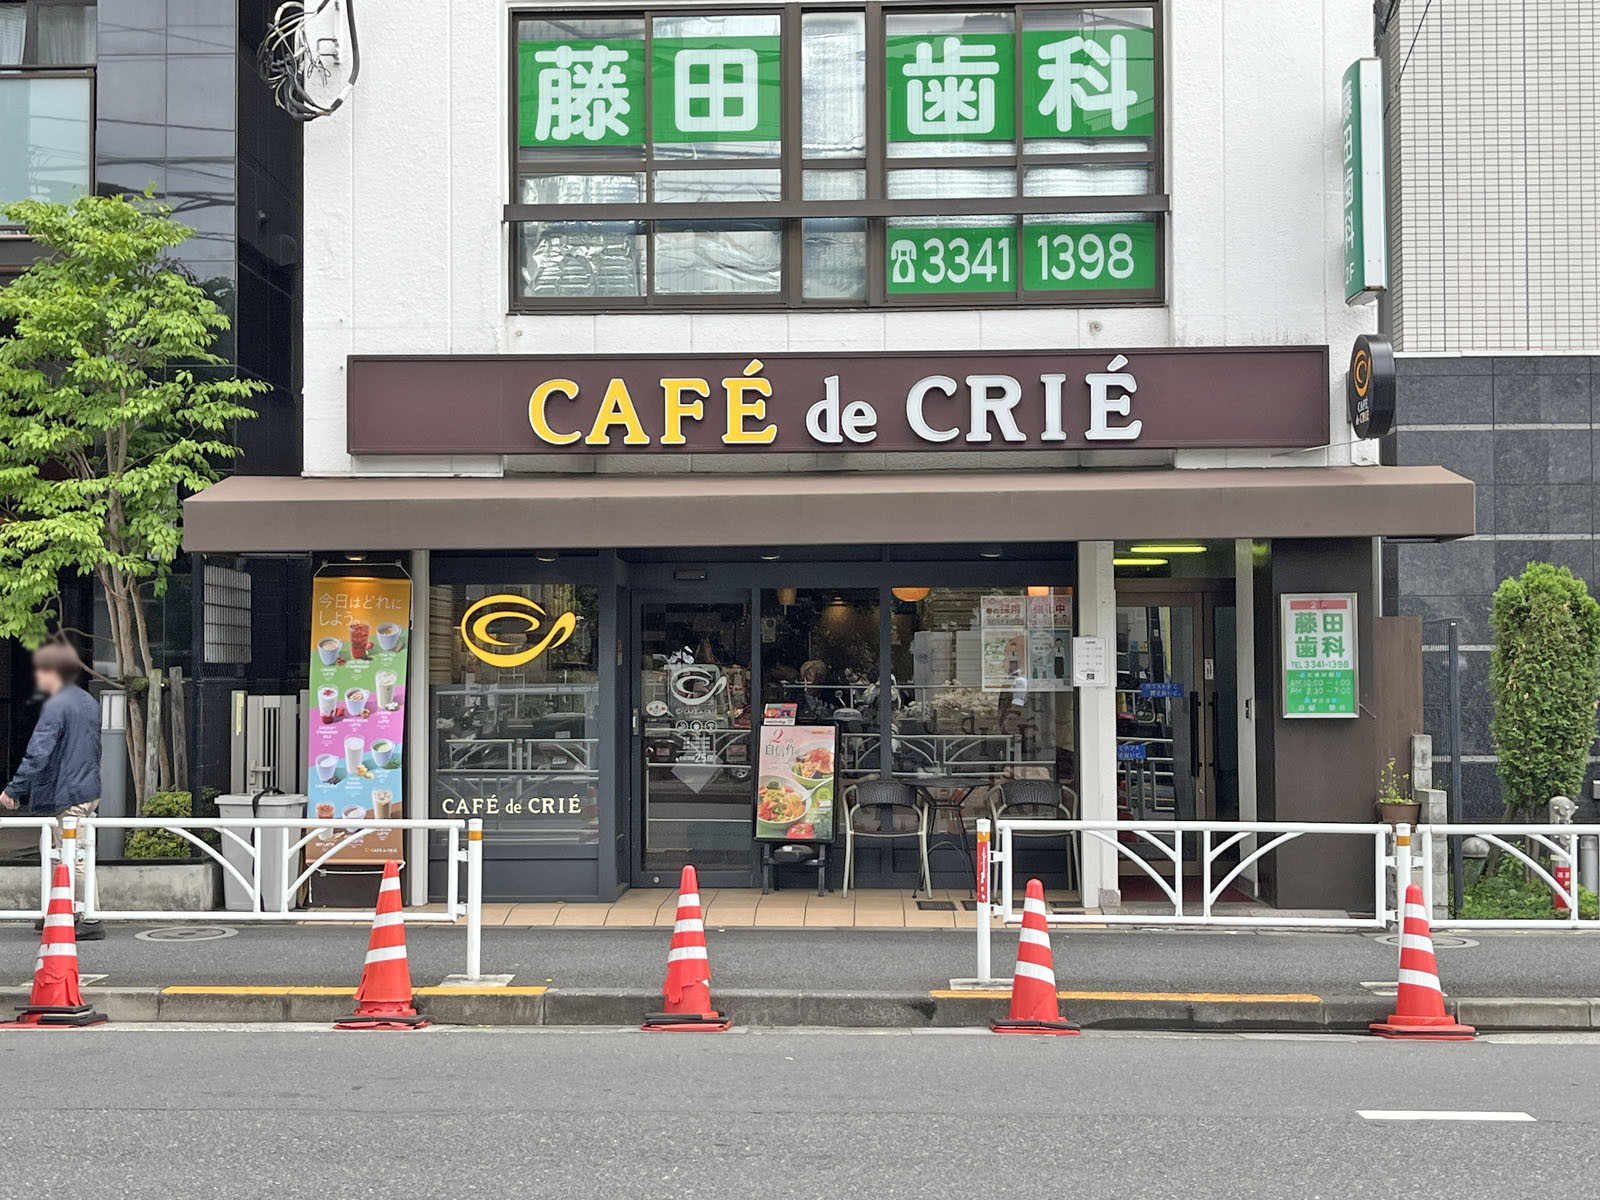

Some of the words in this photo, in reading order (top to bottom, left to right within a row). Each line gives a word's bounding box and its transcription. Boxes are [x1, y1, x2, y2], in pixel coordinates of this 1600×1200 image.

[923, 236, 1010, 283] 3341
[1037, 233, 1134, 280] 1398
[528, 358, 779, 446] CAFÉ
[805, 375, 878, 444] de
[906, 354, 1144, 443] CRIÉ
[318, 592, 403, 610] 今日はどれに
[1294, 611, 1344, 634] 藤田
[1294, 635, 1345, 658] 歯科
[442, 794, 499, 815] CAFÉ
[505, 798, 522, 814] de
[528, 794, 582, 814] CRIÉ
